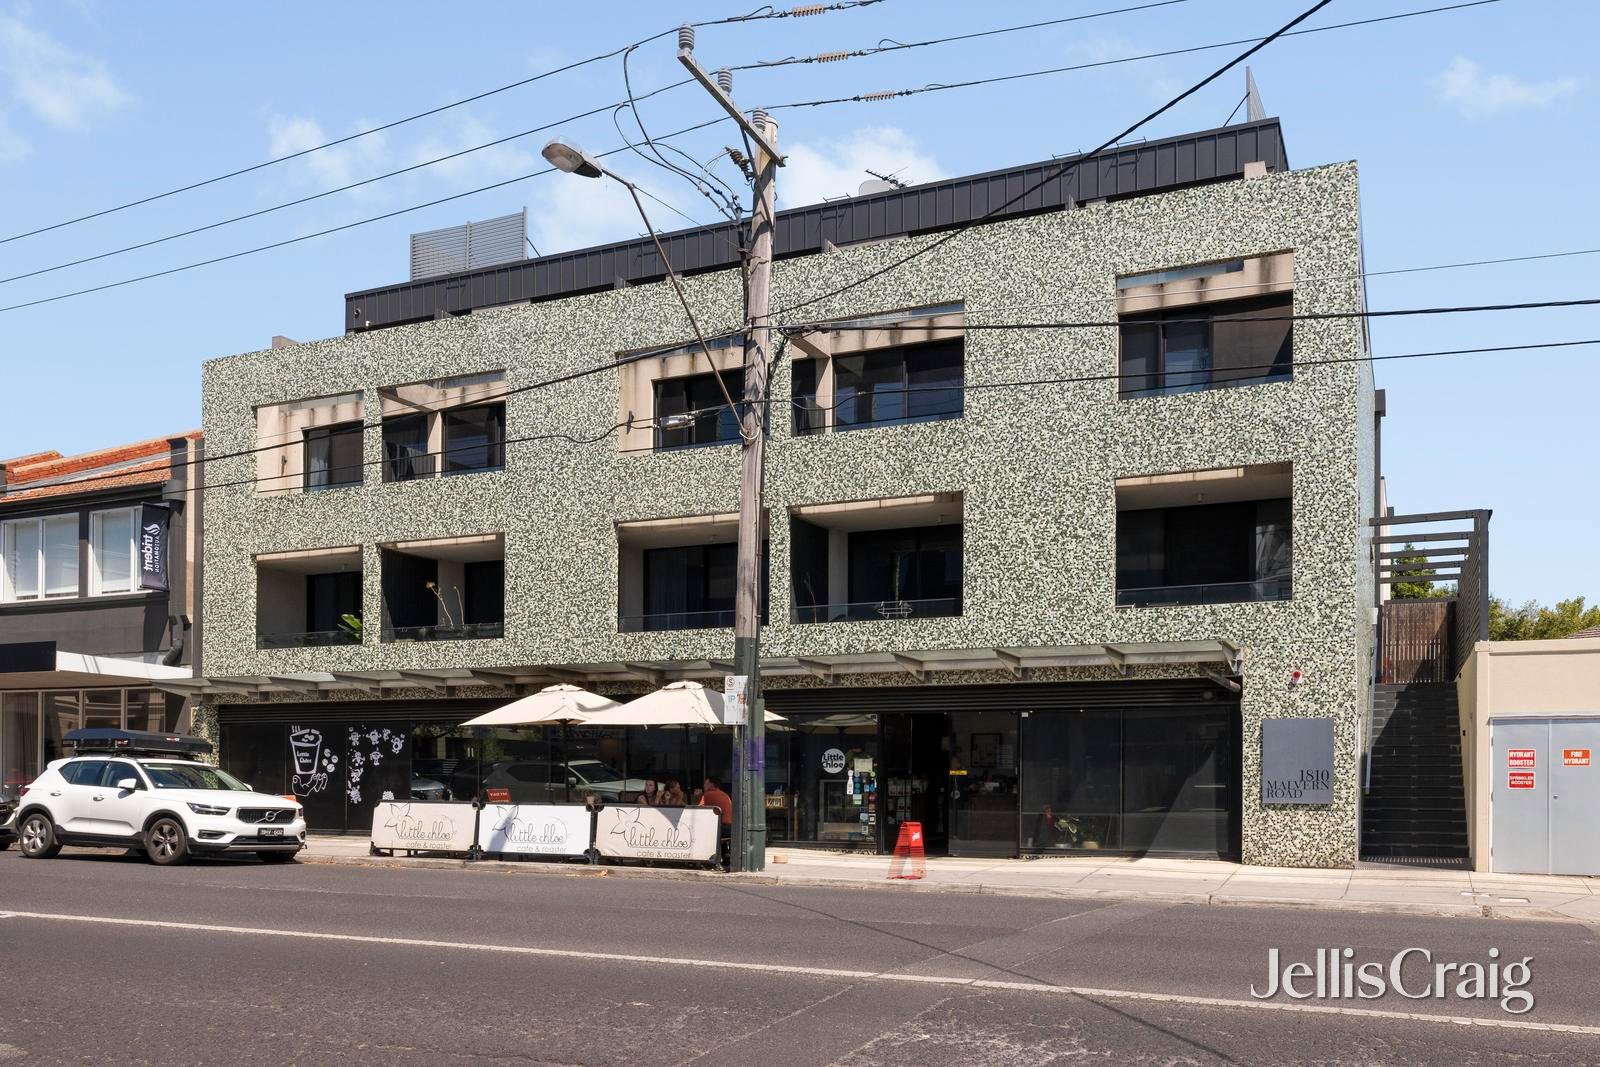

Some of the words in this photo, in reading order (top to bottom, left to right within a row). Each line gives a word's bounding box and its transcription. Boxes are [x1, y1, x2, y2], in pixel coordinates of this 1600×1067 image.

[824, 753, 844, 761] Little
[1300, 769, 1330, 782] 1810
[1267, 780, 1329, 790] MALVERN
[1267, 788, 1303, 798] ROAD
[399, 820, 426, 840] little
[427, 820, 451, 840] chloe
[508, 822, 538, 843] little
[539, 823, 564, 844] chloe
[629, 826, 659, 847] little
[660, 827, 689, 848] chloe
[636, 850, 654, 858] cafe
[664, 851, 692, 859] roaster
